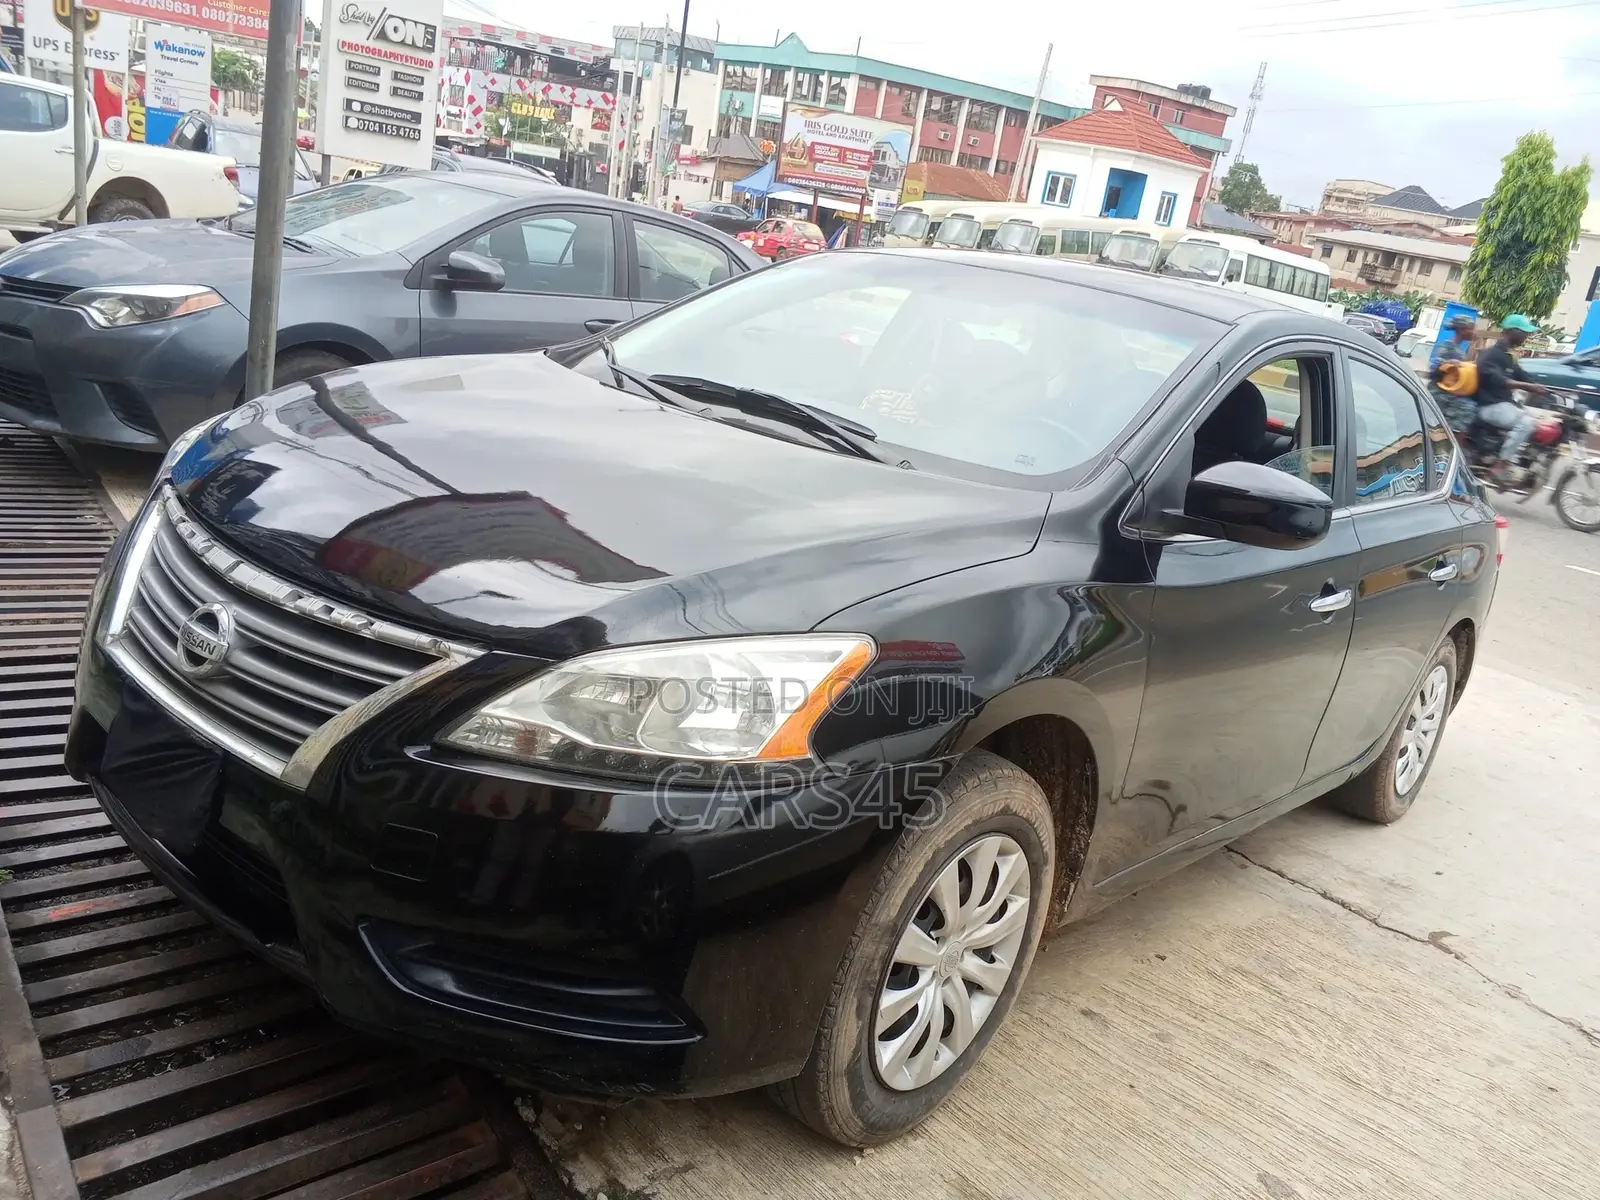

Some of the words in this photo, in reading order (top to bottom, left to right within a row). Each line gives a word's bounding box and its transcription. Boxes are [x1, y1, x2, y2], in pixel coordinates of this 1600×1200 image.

[208, 0, 247, 12] Customer
[33, 36, 59, 51] UPS
[64, 41, 117, 61] Epress
[154, 39, 206, 58] Wakanow
[160, 54, 178, 63] Travel
[180, 56, 199, 66] Centre
[154, 69, 174, 78] Flights
[350, 62, 379, 74] PORTRAIT
[397, 73, 422, 84] FASHION
[349, 79, 379, 91] EDITORIAL
[397, 89, 419, 99] BEAUTY
[358, 120, 380, 133] 0704
[382, 125, 397, 136] 155
[399, 127, 420, 140] 4766
[804, 119, 822, 130] IRIS
[823, 123, 849, 135] GOLD
[850, 128, 874, 140] SUITE
[807, 129, 825, 137] HOTEL
[838, 134, 869, 144] APARTMENT
[181, 628, 217, 656] ISSAN
